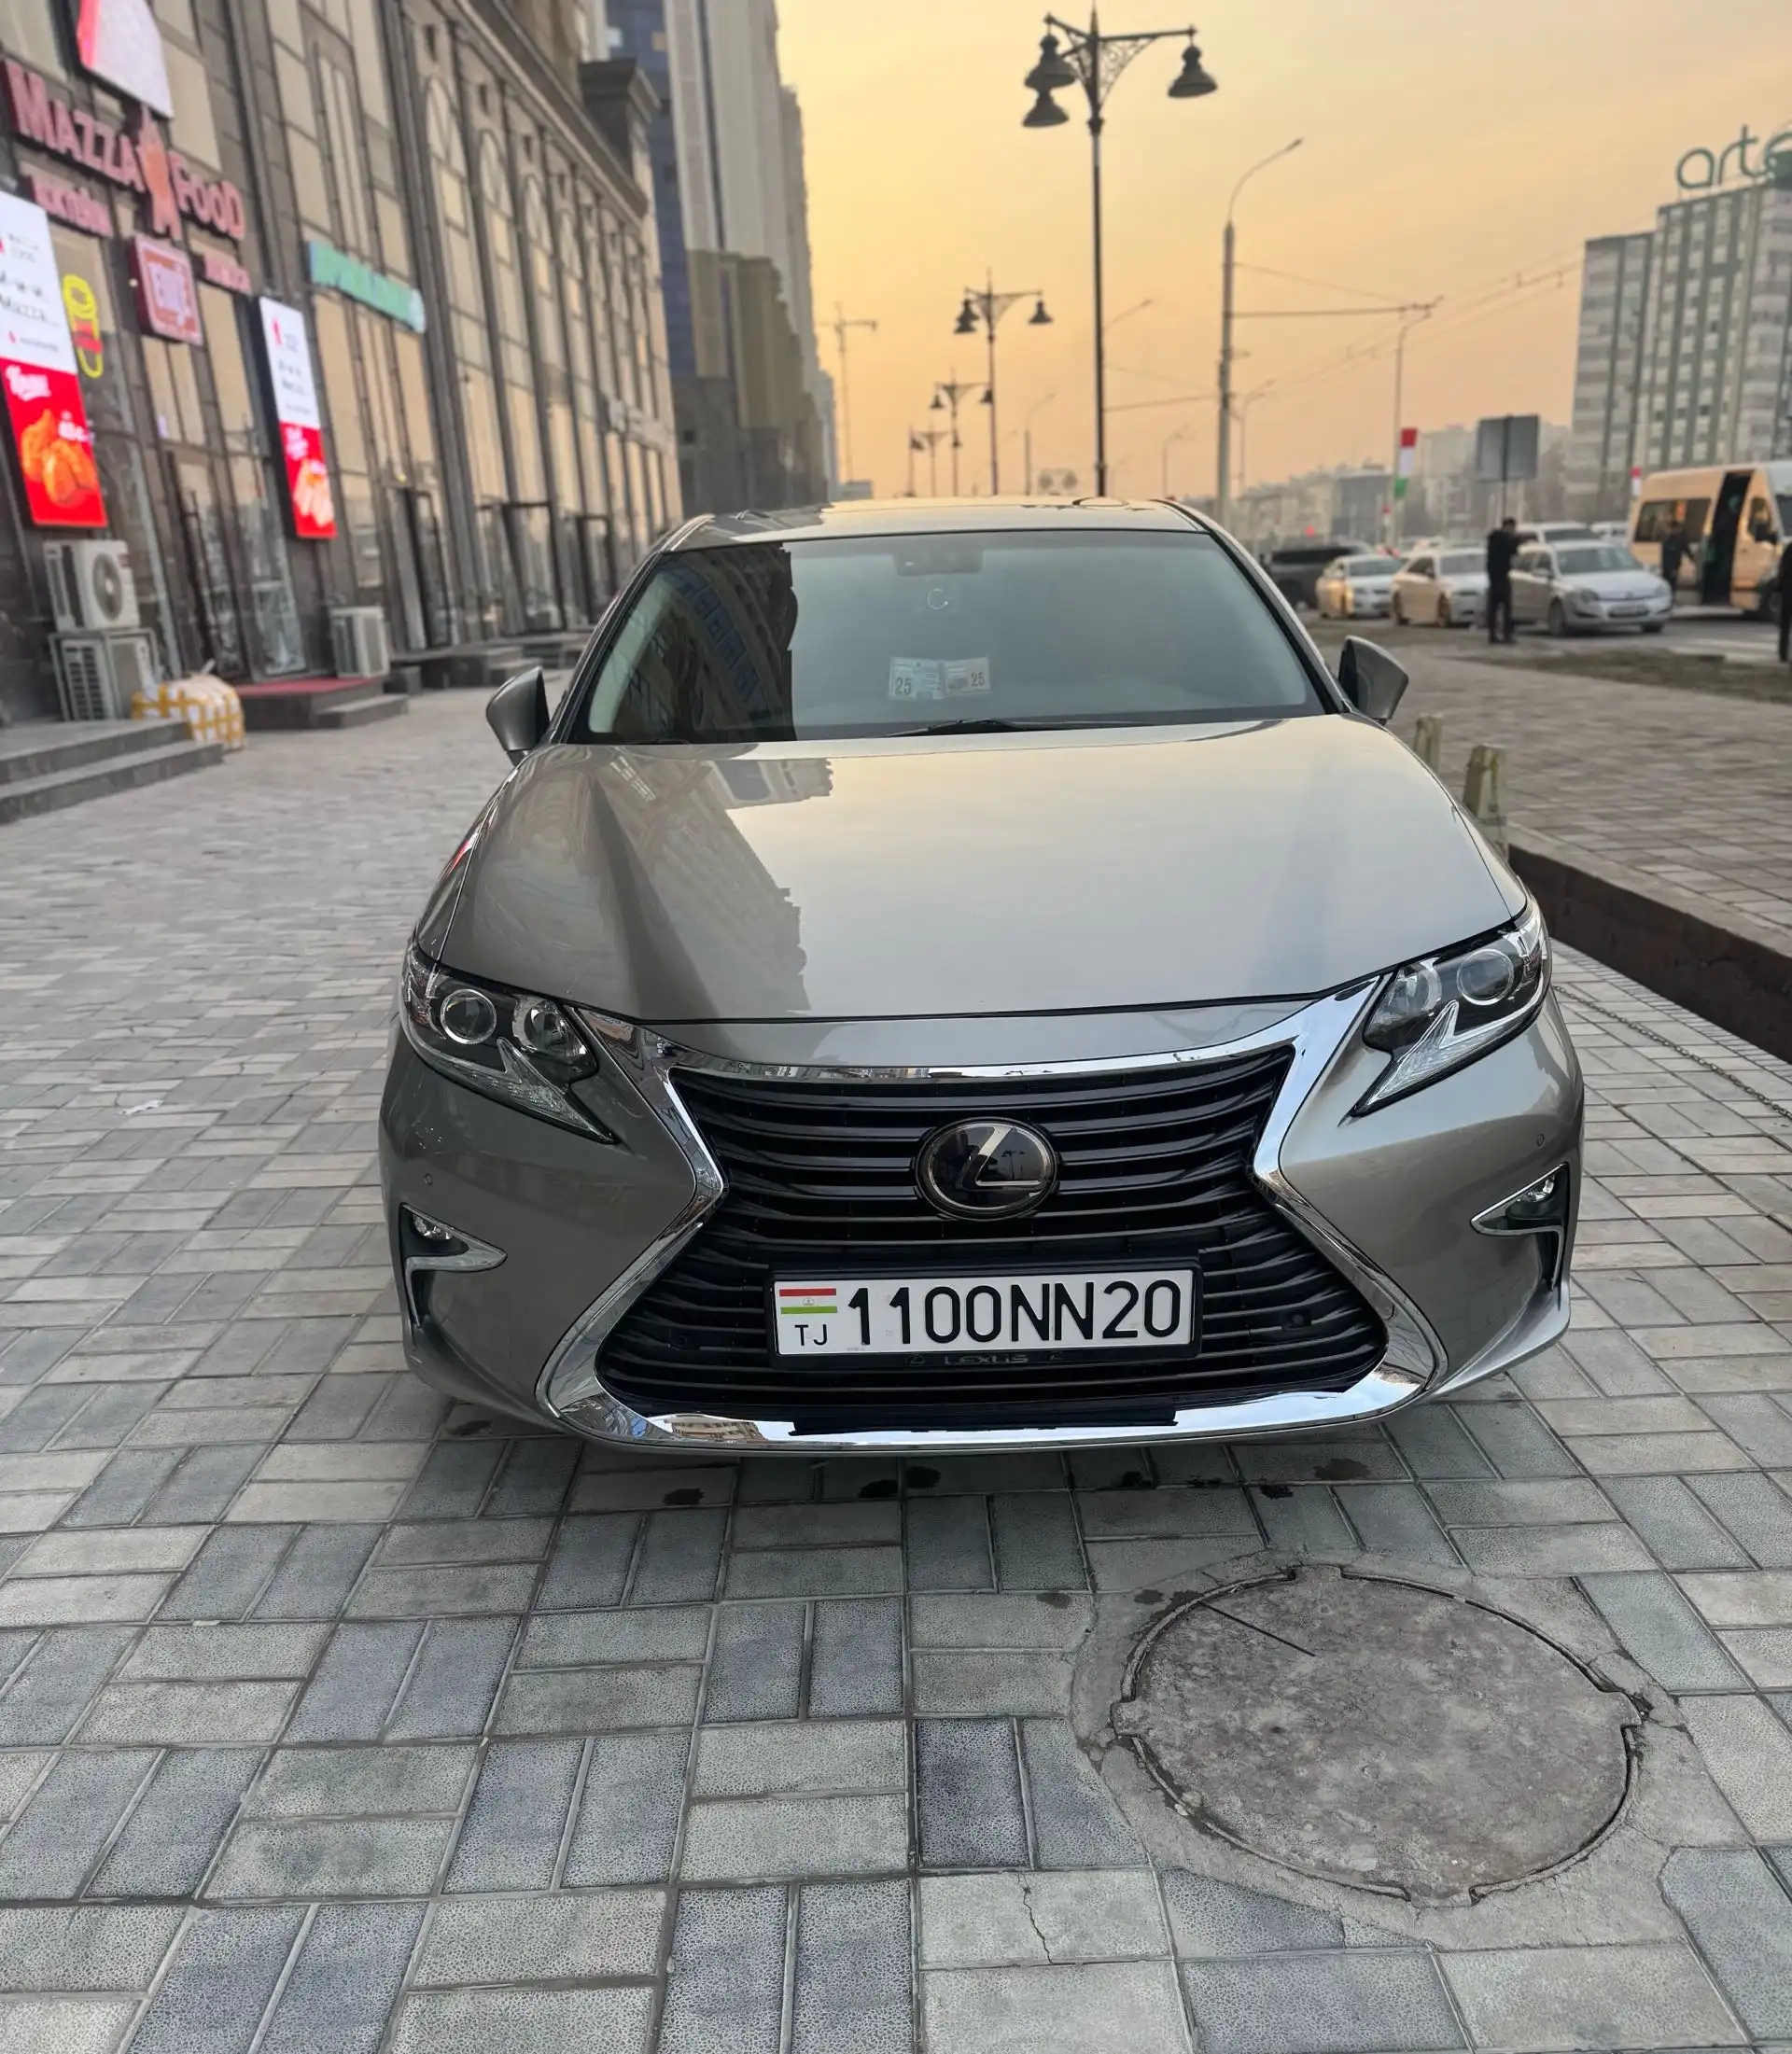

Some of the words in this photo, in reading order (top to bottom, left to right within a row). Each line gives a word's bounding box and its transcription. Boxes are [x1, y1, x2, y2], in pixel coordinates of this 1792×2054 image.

[5, 58, 145, 192] MAZZA
[894, 677, 912, 695] 25
[971, 672, 986, 687] 25
[848, 1279, 1181, 1346] 1100NN20
[794, 1323, 828, 1347] TJ
[945, 1354, 1029, 1366] LEXUS
